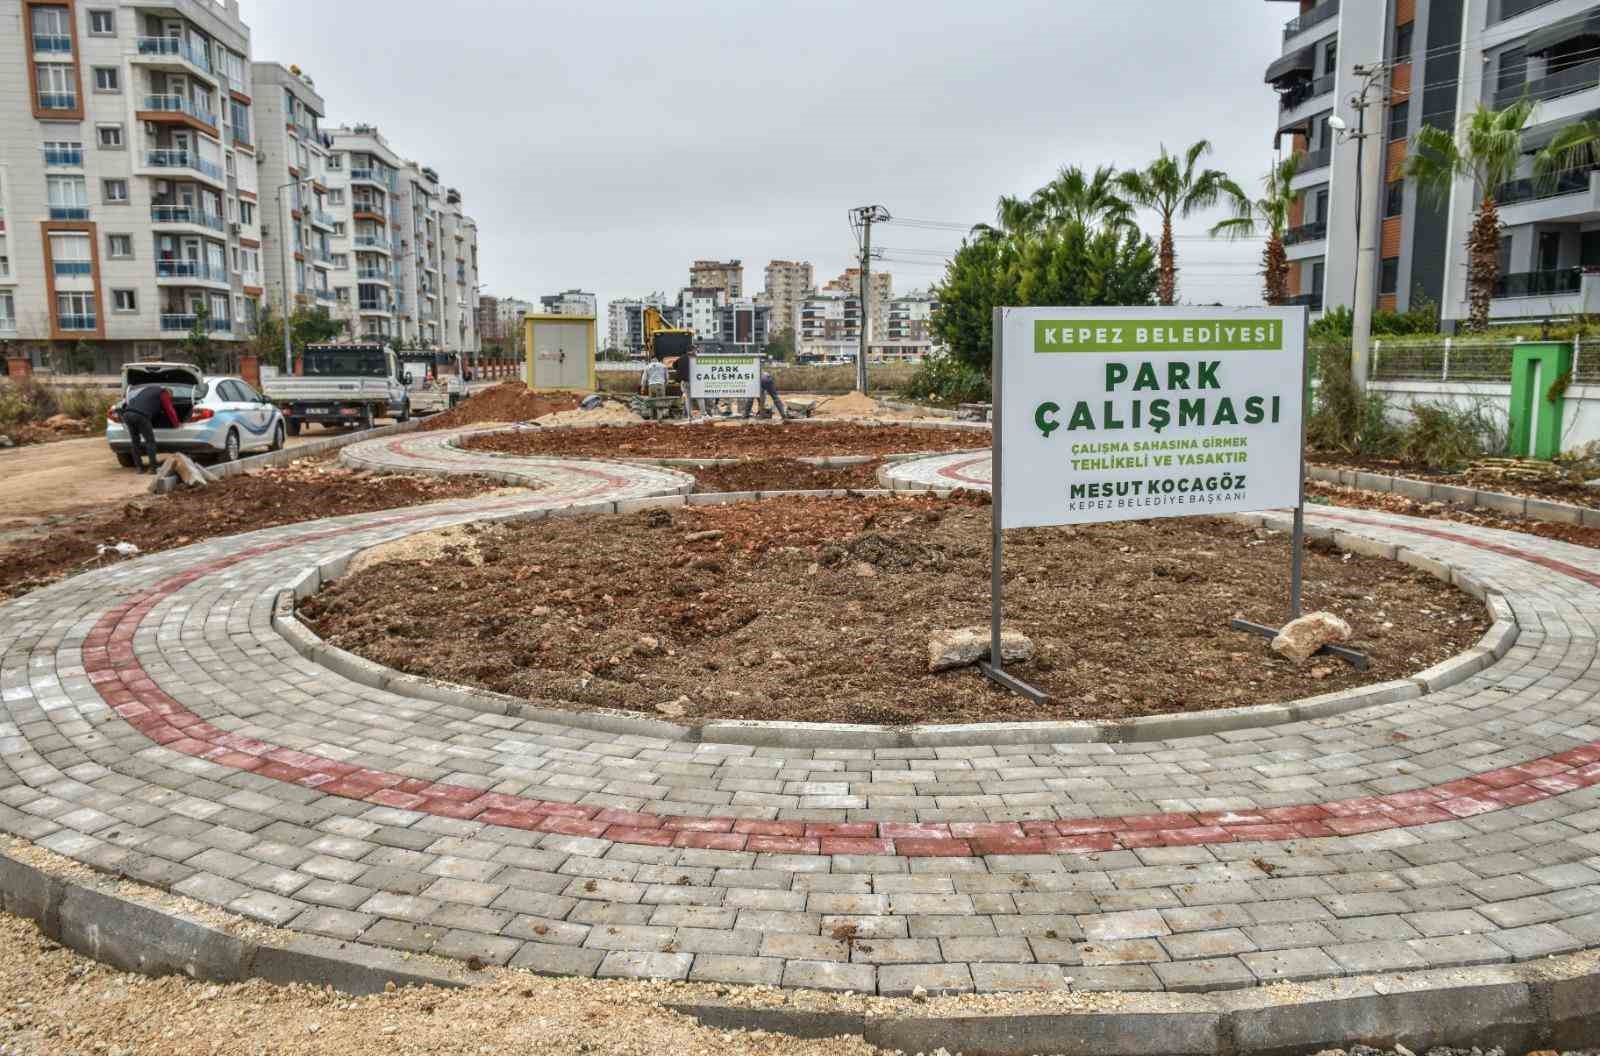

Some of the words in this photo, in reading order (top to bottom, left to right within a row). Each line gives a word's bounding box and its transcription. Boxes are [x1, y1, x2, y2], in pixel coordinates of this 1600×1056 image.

[1044, 327, 1123, 344] KEPEZ
[1136, 323, 1275, 343] BELEDİYESİ
[1105, 360, 1221, 392] PARK
[1034, 395, 1281, 438] ÇALIŞMASI
[1071, 441, 1129, 455] ÇALIŞMA
[1133, 439, 1198, 452] SAHASINA
[1202, 436, 1248, 449] GİRMEK
[1070, 455, 1148, 471] TEHLİKELİ
[1153, 455, 1172, 467] VE
[1178, 451, 1248, 466] YASAKTIR
[1070, 480, 1143, 499] MESUT
[1147, 472, 1246, 495] KOCAGÖZ
[1069, 499, 1113, 512] KEPEZ
[1118, 494, 1184, 508] BELEDİYE
[1189, 491, 1247, 505] BAŞKANI
